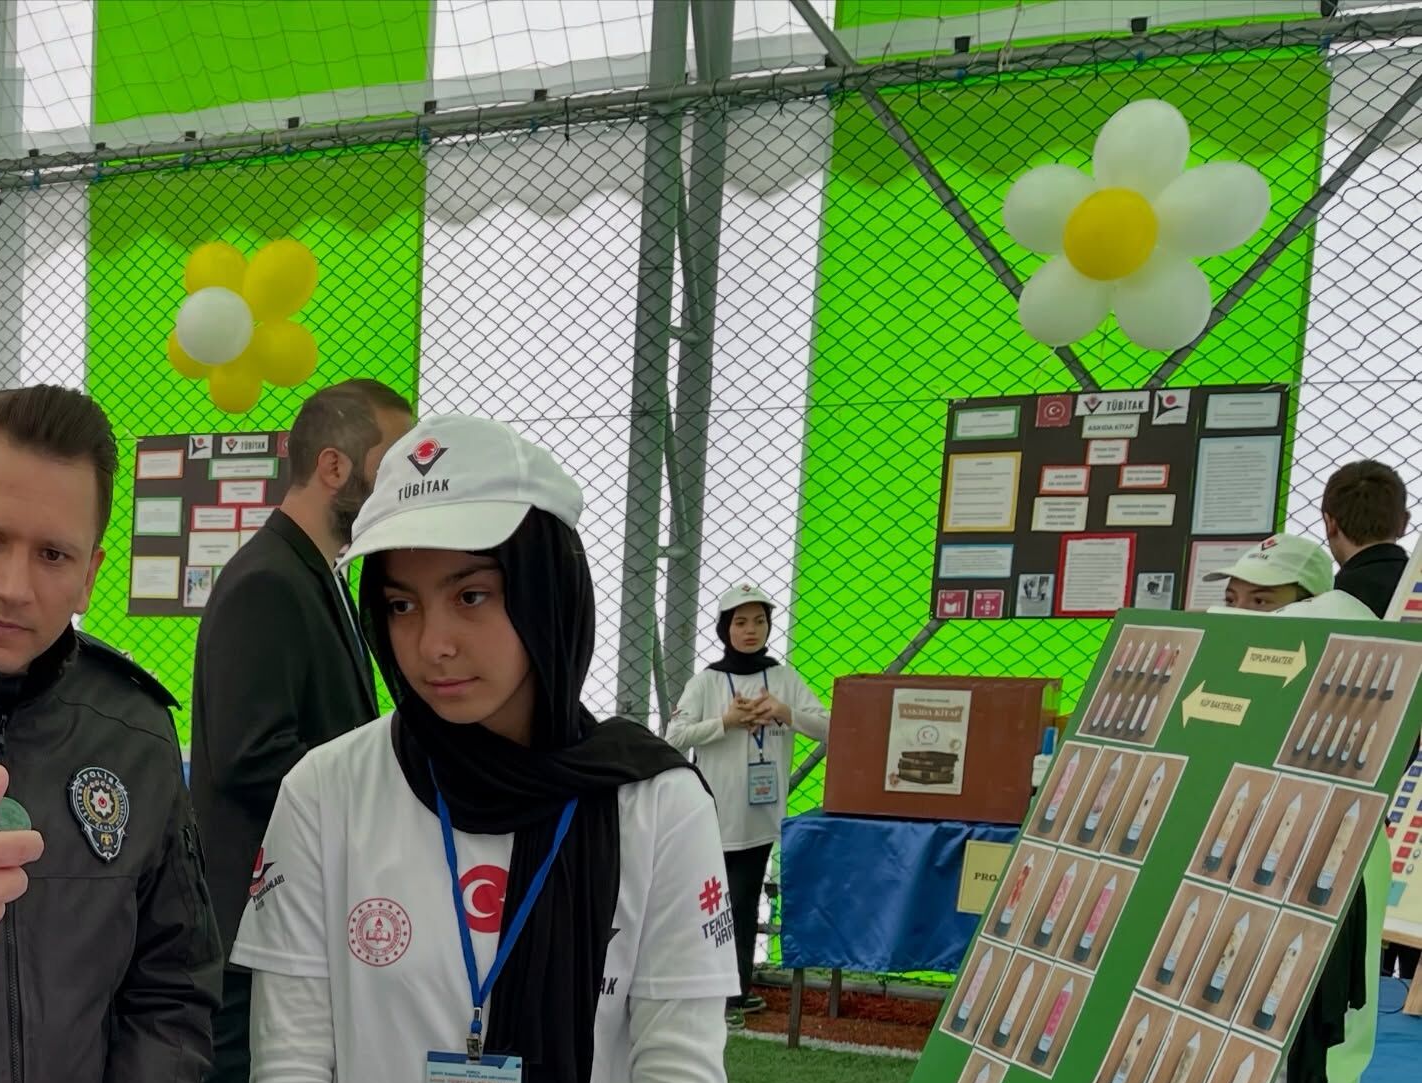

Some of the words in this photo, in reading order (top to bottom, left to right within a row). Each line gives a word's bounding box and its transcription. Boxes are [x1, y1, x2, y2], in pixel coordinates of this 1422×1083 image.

[1106, 399, 1144, 412] TÜBİTAK
[398, 478, 450, 501] TÜBİTAK
[973, 872, 999, 882] PRO
